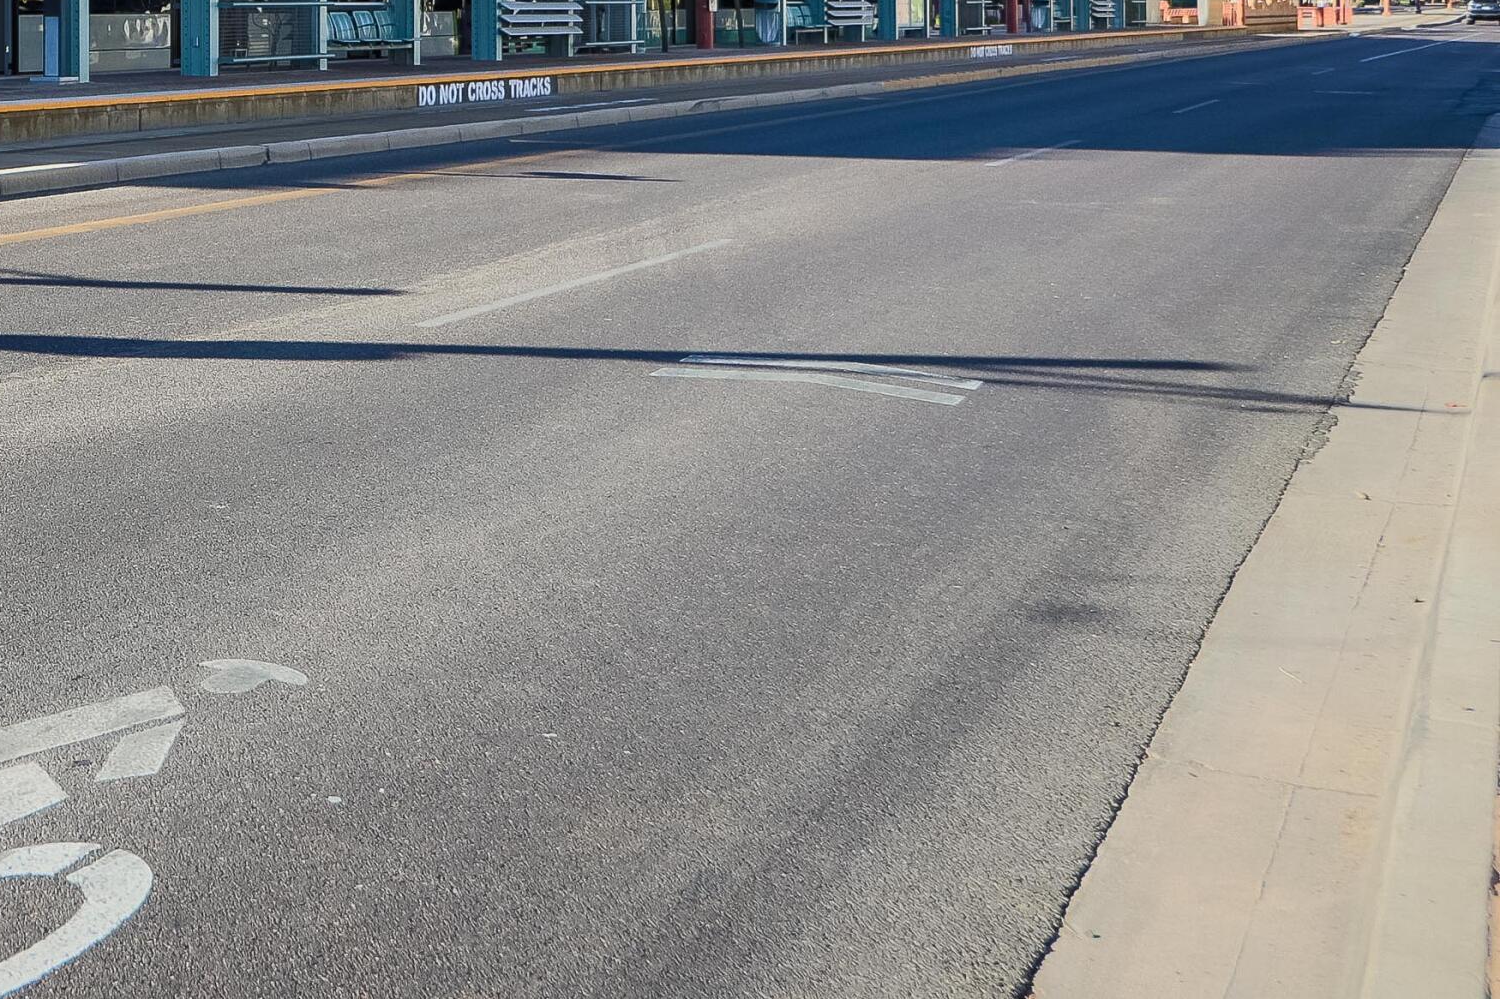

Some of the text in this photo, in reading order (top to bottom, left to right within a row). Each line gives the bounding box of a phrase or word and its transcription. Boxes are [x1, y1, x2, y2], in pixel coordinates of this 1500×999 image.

[418, 76, 551, 107] DO NOT CROSS TRACKS
